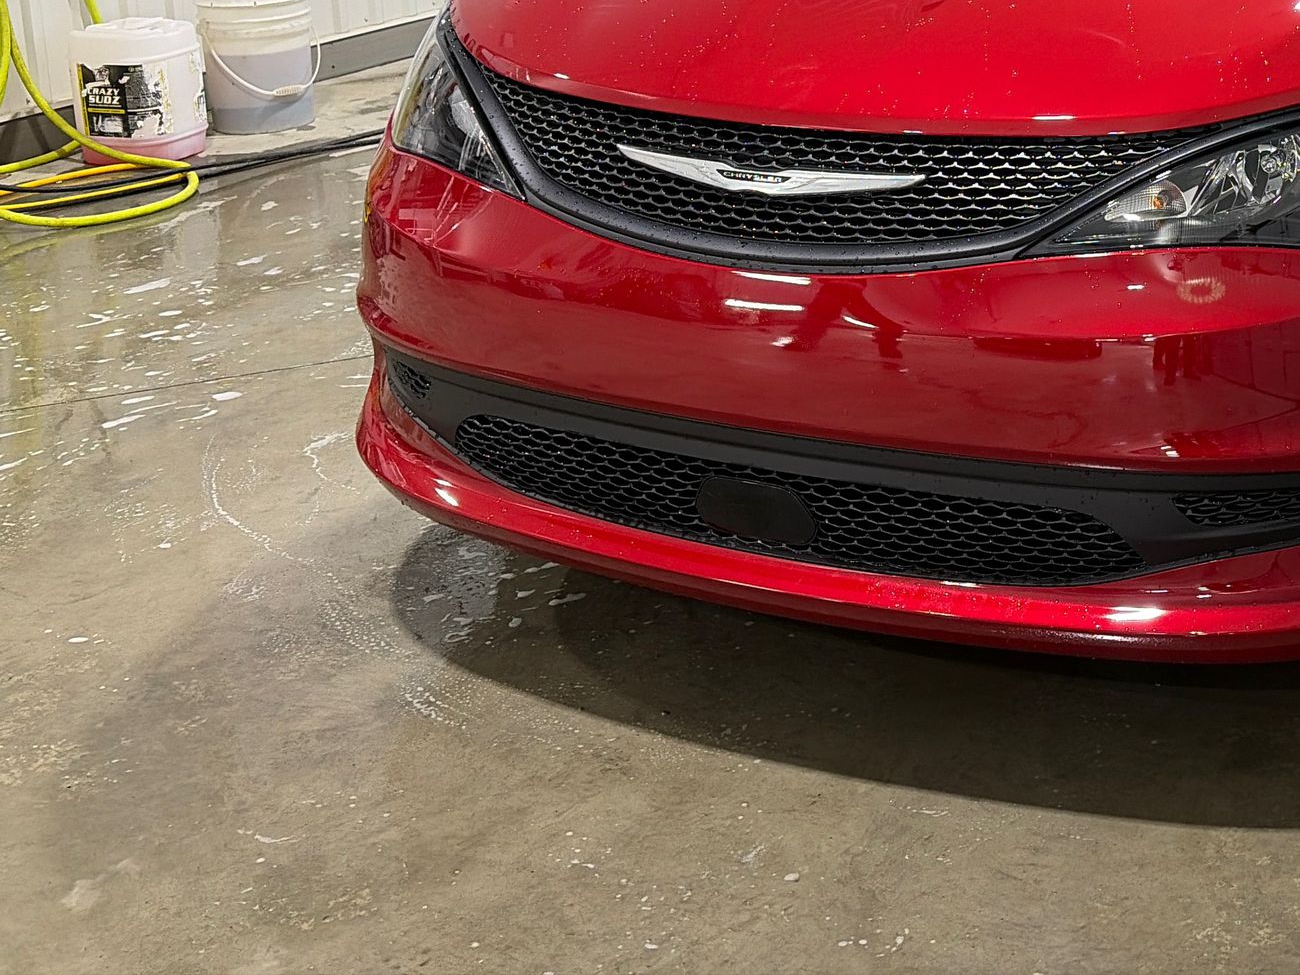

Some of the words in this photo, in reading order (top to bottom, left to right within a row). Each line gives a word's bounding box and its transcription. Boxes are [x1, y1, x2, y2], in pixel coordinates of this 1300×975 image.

[87, 87, 120, 96] CRAZY
[88, 95, 120, 105] SUDZ
[723, 171, 782, 183] CHRYSLER
